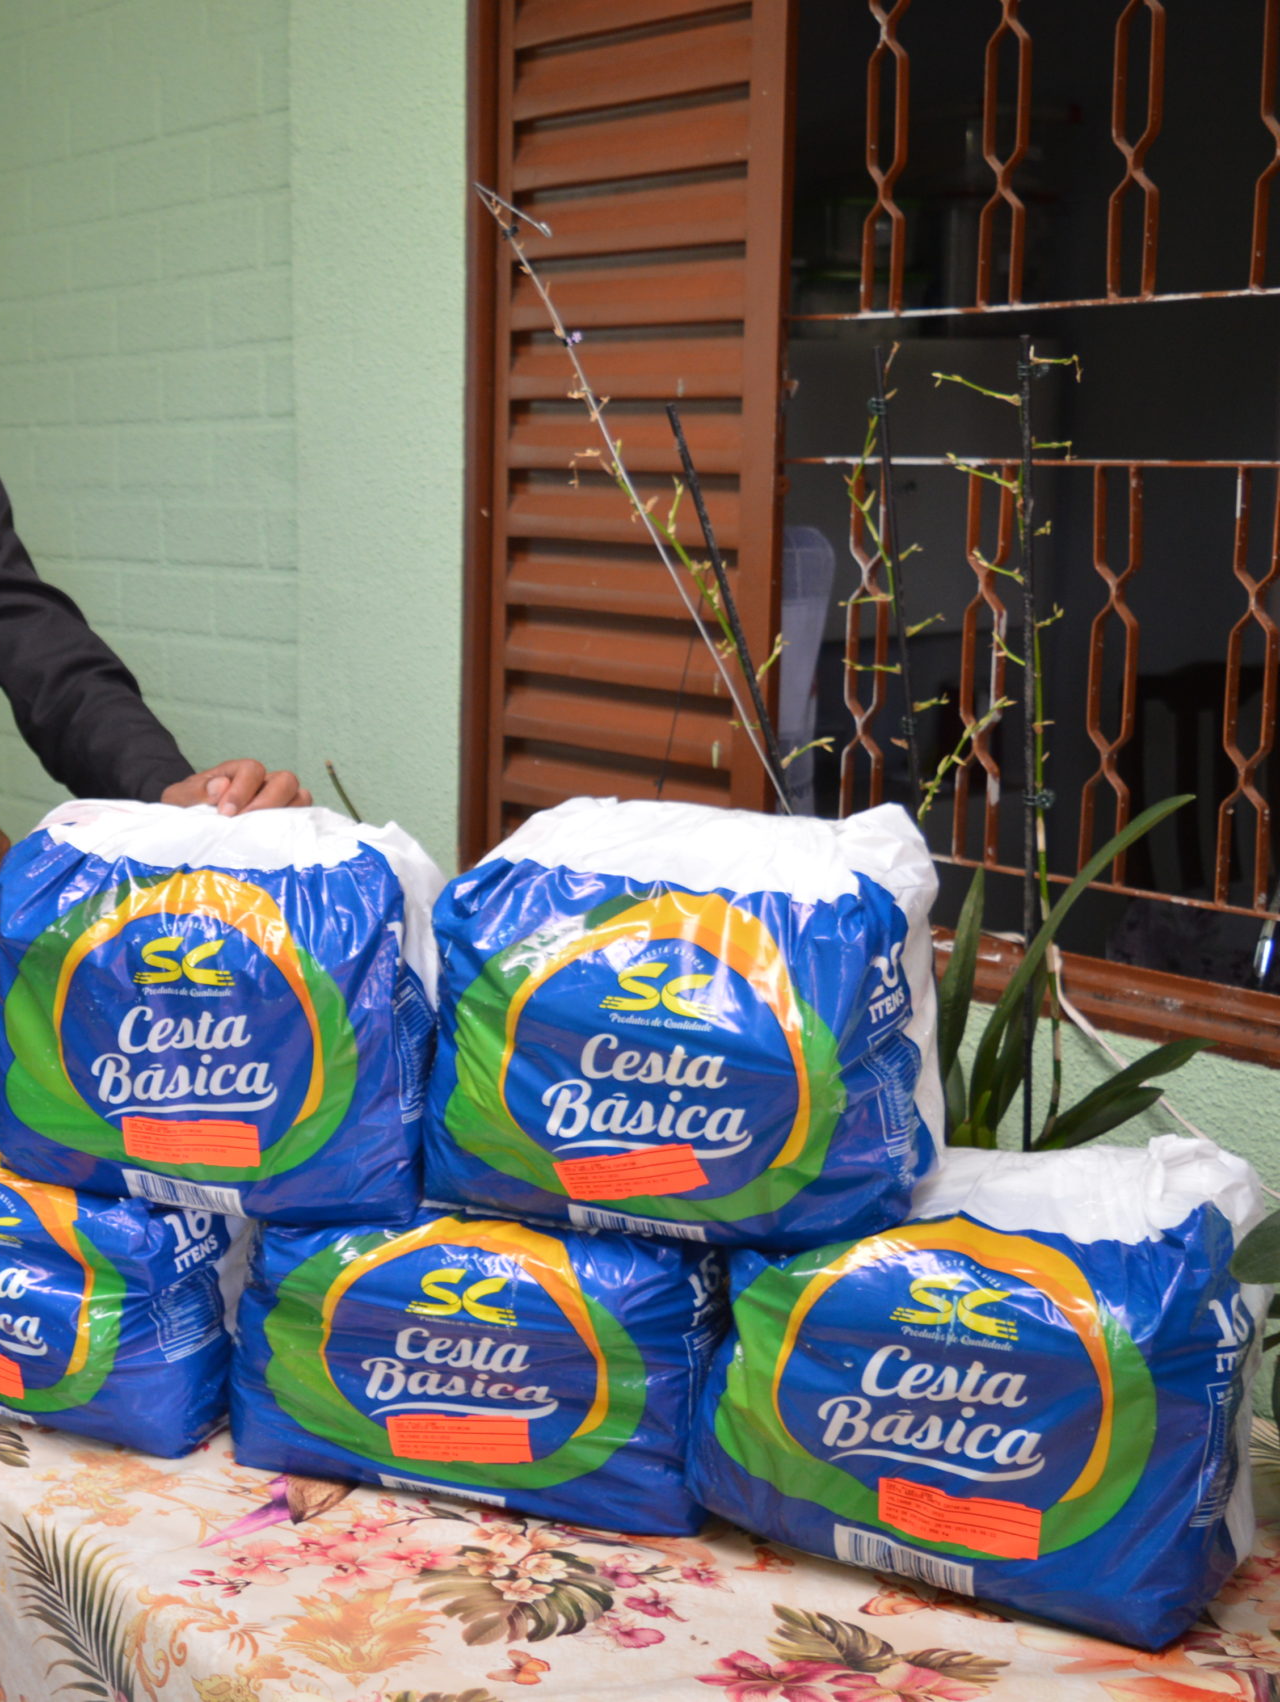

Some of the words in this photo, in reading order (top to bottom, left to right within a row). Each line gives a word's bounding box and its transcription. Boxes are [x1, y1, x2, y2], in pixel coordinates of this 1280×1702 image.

[132, 936, 236, 987] SC
[598, 962, 719, 1022] SC
[868, 986, 905, 1025] ITENS
[118, 1005, 251, 1054] Cesta
[609, 1012, 650, 1027] Produtos
[650, 1017, 662, 1028] de
[663, 1018, 714, 1032] Qualidade
[91, 1053, 277, 1106] Básica
[580, 1033, 728, 1089] Cesta
[541, 1079, 753, 1144] Básica
[163, 1209, 213, 1254] 16
[174, 1234, 218, 1274] ITENS
[405, 1268, 518, 1327] SC
[888, 1272, 1019, 1341] SC
[1208, 1292, 1251, 1350] 16
[394, 1327, 532, 1374] Cesta
[960, 1334, 1013, 1352] Qualidade
[860, 1344, 1029, 1409] Cesta
[816, 1396, 1045, 1467] Básica
